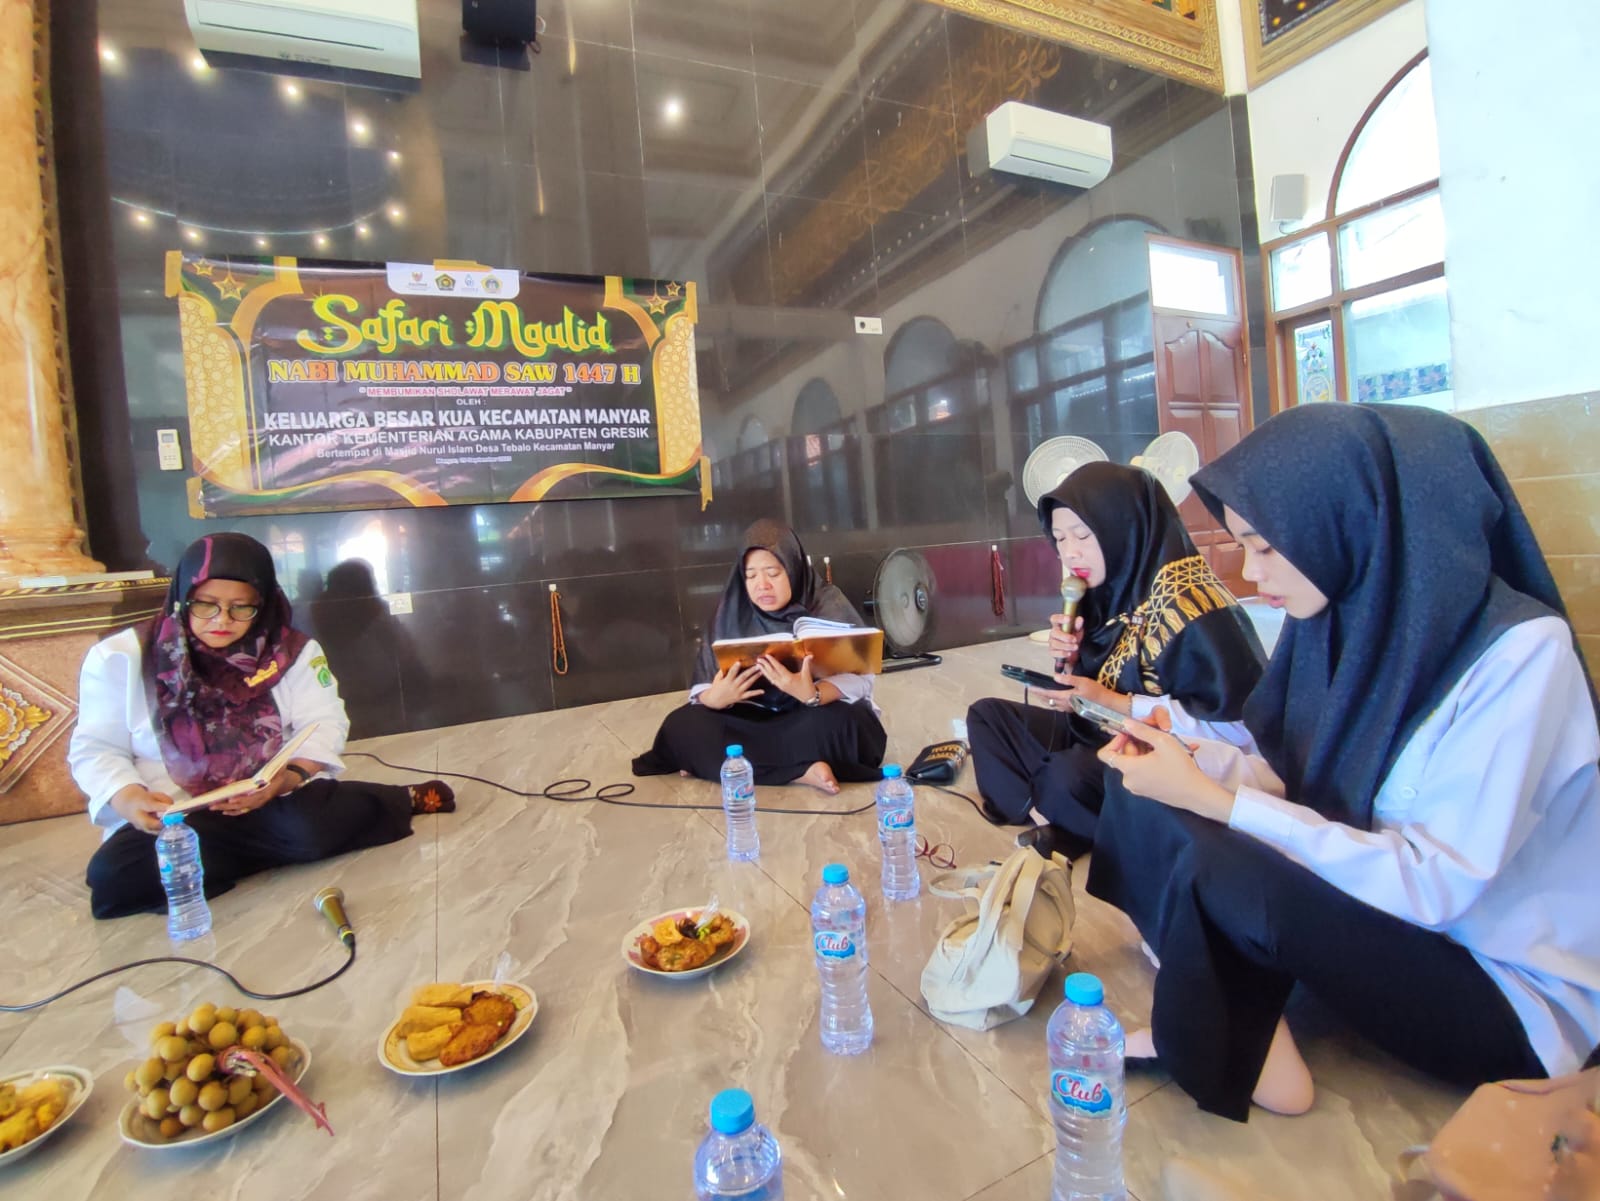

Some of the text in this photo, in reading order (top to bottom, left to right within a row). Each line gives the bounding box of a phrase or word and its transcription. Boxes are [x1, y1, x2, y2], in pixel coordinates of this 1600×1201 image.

[296, 294, 612, 358] Safari Maulid
[267, 359, 641, 385] NABI MUHAMMAD SAW 1447 H
[436, 386, 490, 397] SHOLAWAT
[490, 386, 536, 397] MERAWAT
[456, 398, 481, 406] OLEH
[263, 408, 651, 430] KELUARGA BESAR KUA KECAMATAN MANYAR
[268, 427, 649, 447] KANTOR KEMENTERIAN AGAMA KABUPATEN GRESIK
[316, 447, 371, 459] Bertempat
[372, 446, 383, 456] di
[419, 445, 446, 454] Nurul
[448, 444, 473, 454] Islam
[475, 443, 499, 453] Desa
[501, 443, 531, 452] Tebalo
[533, 441, 582, 452] Kecamatan
[583, 441, 615, 452] Manyar
[1055, 1074, 1103, 1102] Club
